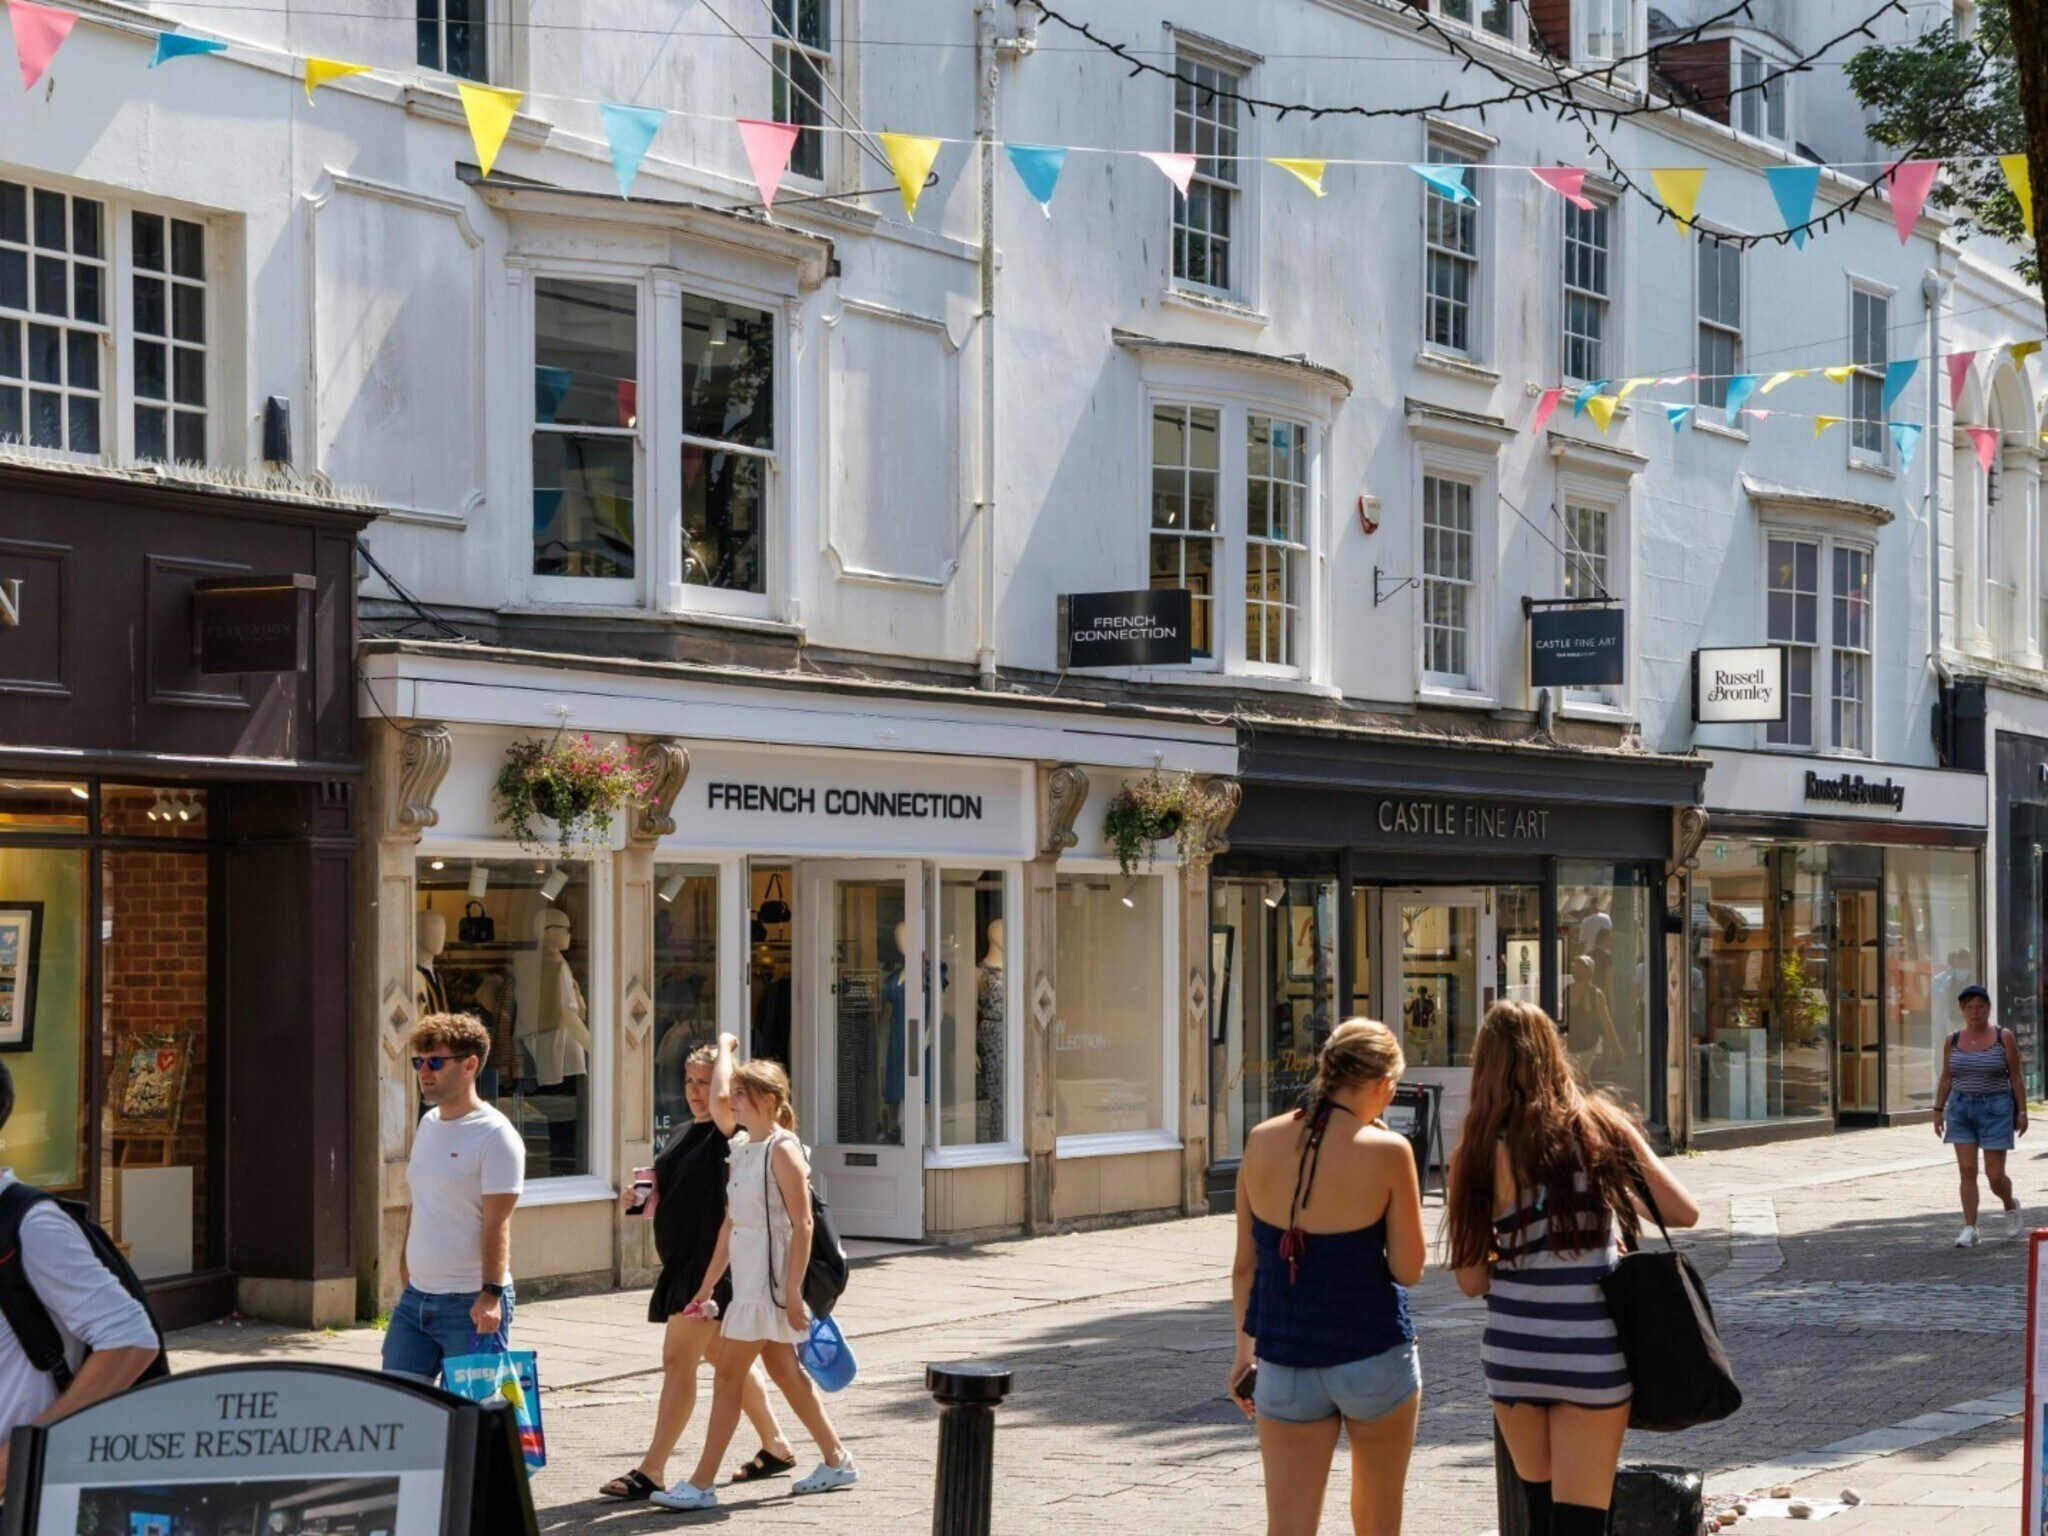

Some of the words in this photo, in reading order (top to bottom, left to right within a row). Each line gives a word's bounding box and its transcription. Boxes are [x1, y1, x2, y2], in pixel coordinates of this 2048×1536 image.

[1093, 615, 1157, 628] FRENCH
[1074, 627, 1177, 642] CONNECTION
[1535, 639, 1571, 649] CASTLE
[1574, 638, 1596, 648] FINE
[1598, 637, 1617, 647] ART
[1715, 669, 1764, 686] Russell
[708, 782, 816, 814] FRENCH
[824, 789, 983, 820] CONNECTION
[1378, 800, 1456, 835] CASTLE
[1464, 806, 1506, 838] FINE
[1513, 809, 1550, 840] ART
[1056, 1033, 1107, 1051] LLECTION
[215, 1391, 279, 1421] THE
[87, 1432, 185, 1463] HOUSE
[194, 1422, 404, 1459] RESTAURANT
